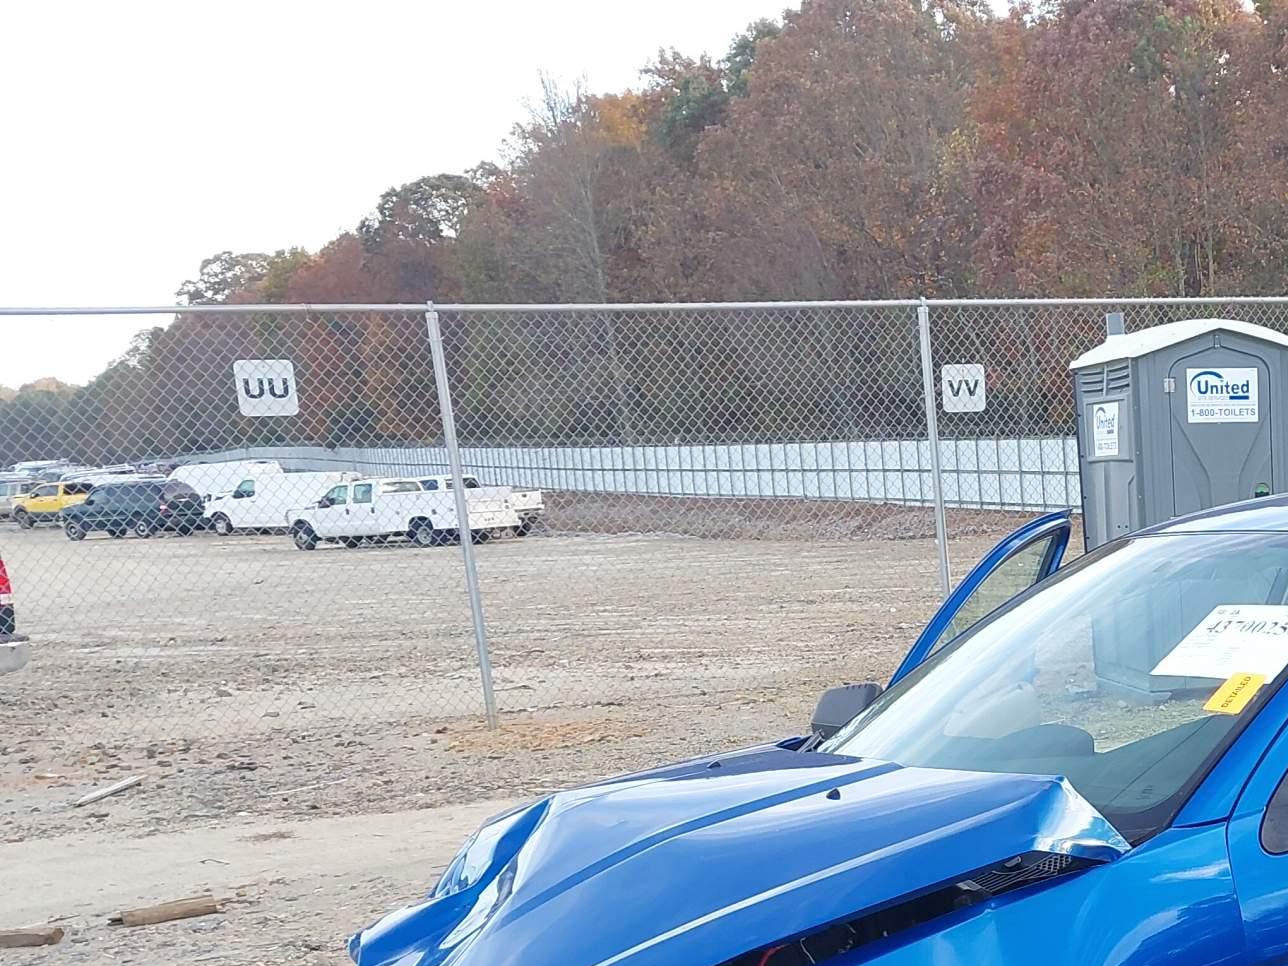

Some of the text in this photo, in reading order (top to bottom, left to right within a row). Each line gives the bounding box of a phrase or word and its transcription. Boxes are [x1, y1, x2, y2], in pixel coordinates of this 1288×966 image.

[242, 377, 289, 399] UU
[947, 379, 980, 397] VV
[1197, 379, 1250, 395] United
[1191, 408, 1256, 417] 1-800-TOILETS
[1220, 676, 1251, 708] DETAILED
